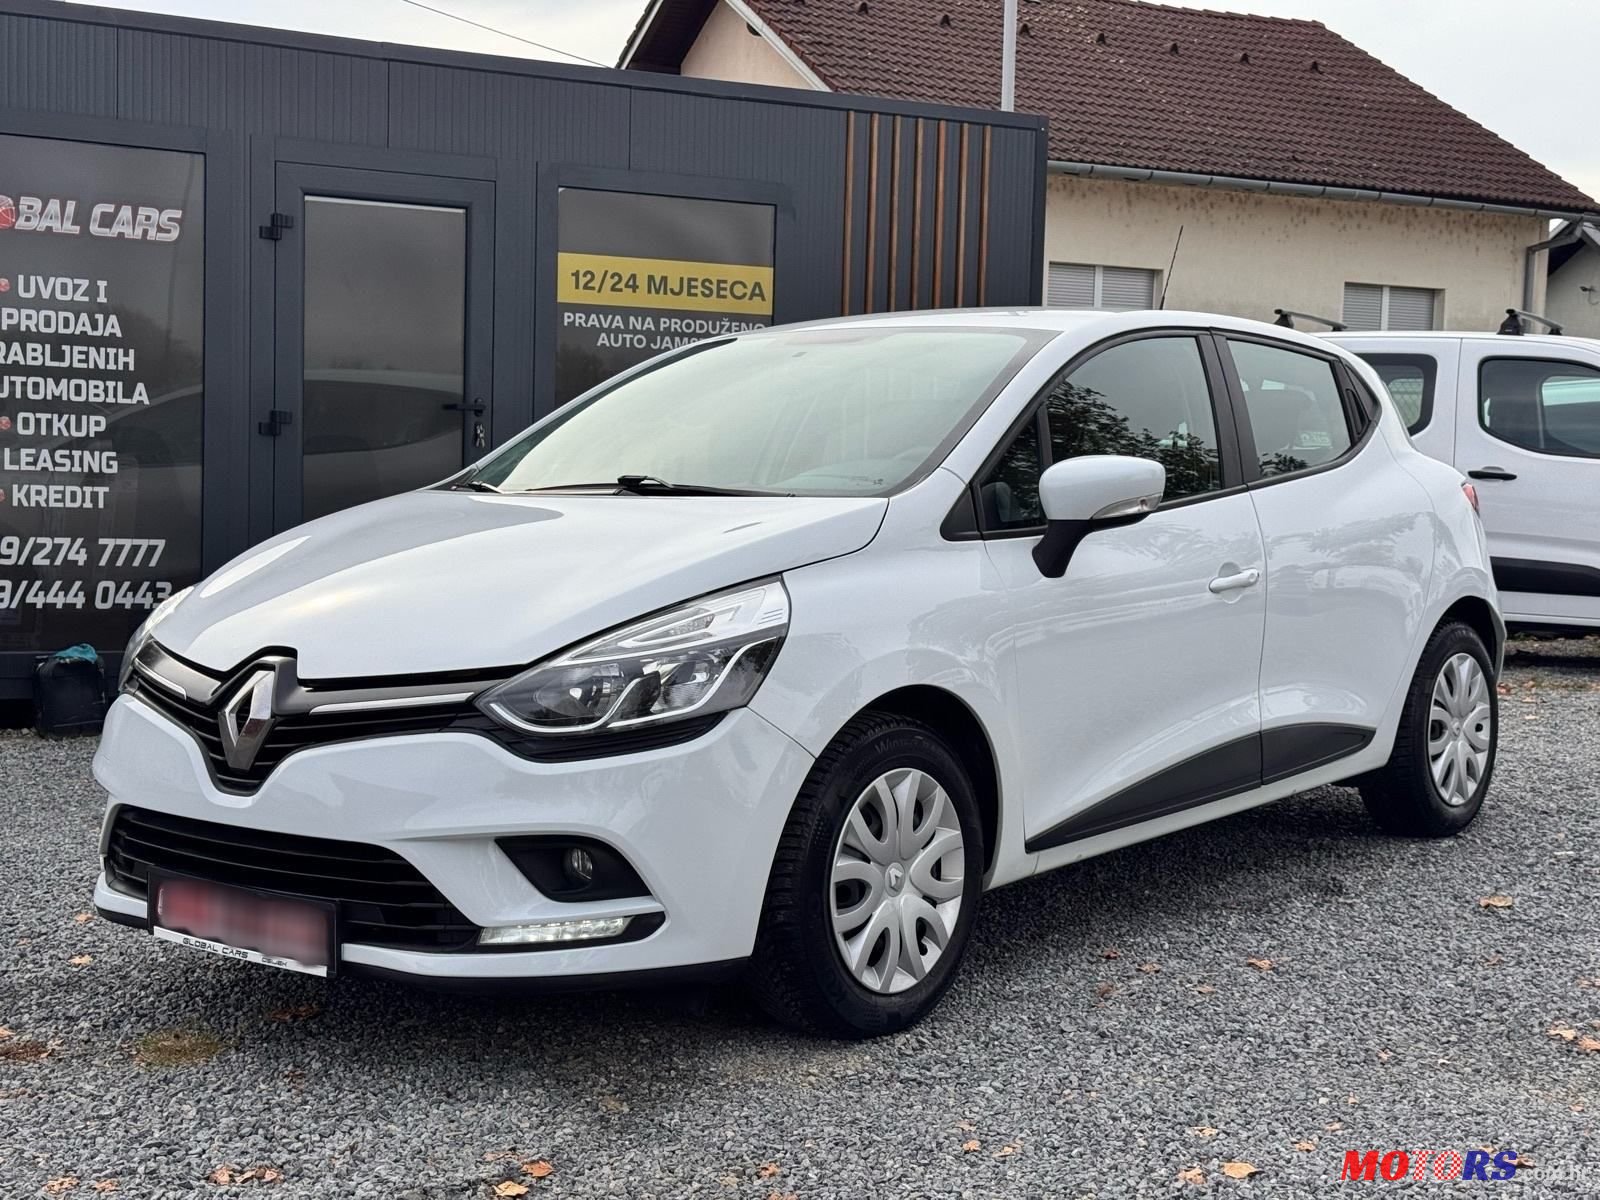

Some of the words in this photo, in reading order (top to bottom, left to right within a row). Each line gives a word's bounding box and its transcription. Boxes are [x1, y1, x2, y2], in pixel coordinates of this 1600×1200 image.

[89, 203, 182, 242] CARS
[18, 274, 89, 302] UVOZ
[96, 280, 108, 303] I
[571, 269, 639, 293] 12/24
[647, 274, 766, 302] MJESECA
[1, 307, 122, 338] PRODAJA
[563, 312, 623, 330] PRAVA
[629, 316, 656, 332] NA
[596, 332, 647, 349] AUTO
[650, 335, 705, 350] JAM
[17, 411, 106, 438] OTKUP
[4, 447, 119, 474] LEASING
[12, 484, 110, 509] KREDIT
[98, 538, 166, 567] 7777
[95, 580, 173, 610] 0443
[184, 938, 218, 952] GLOBAL
[222, 947, 248, 959] CARS
